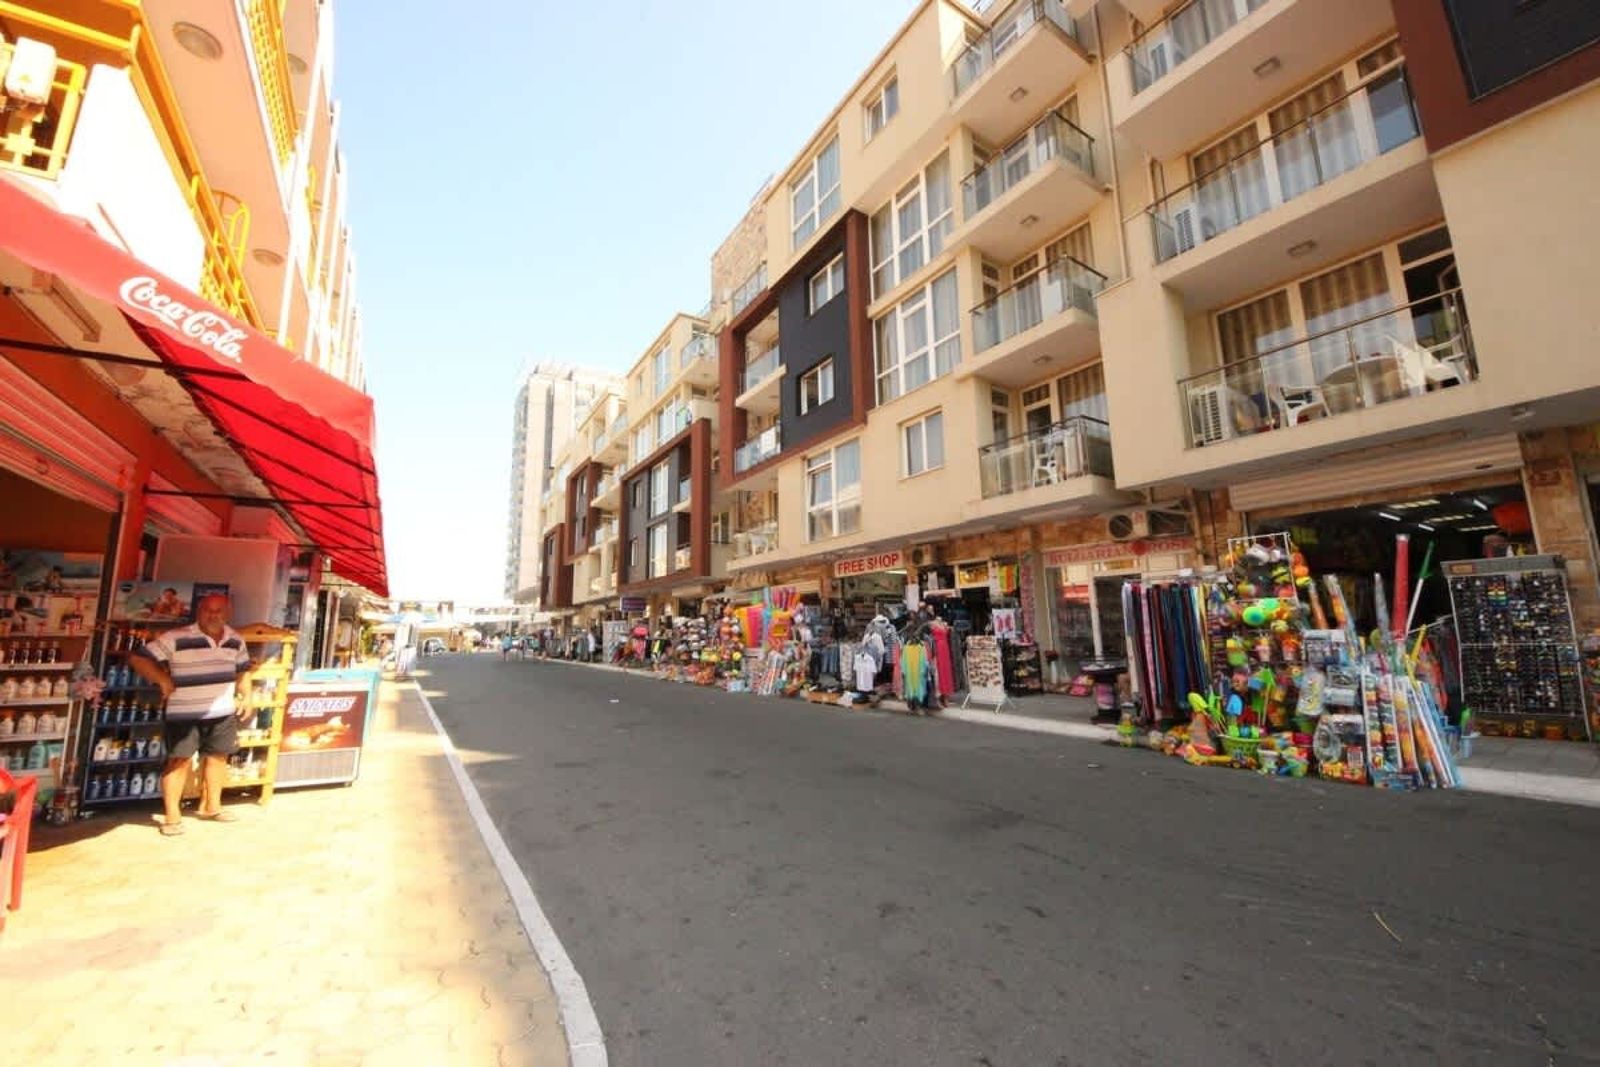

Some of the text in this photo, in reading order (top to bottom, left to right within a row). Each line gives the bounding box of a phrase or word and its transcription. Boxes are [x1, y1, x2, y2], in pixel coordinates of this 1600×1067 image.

[119, 276, 248, 363] Coca-Cola
[838, 553, 899, 574] FREE SHOP
[289, 697, 355, 713] SNICKERS
